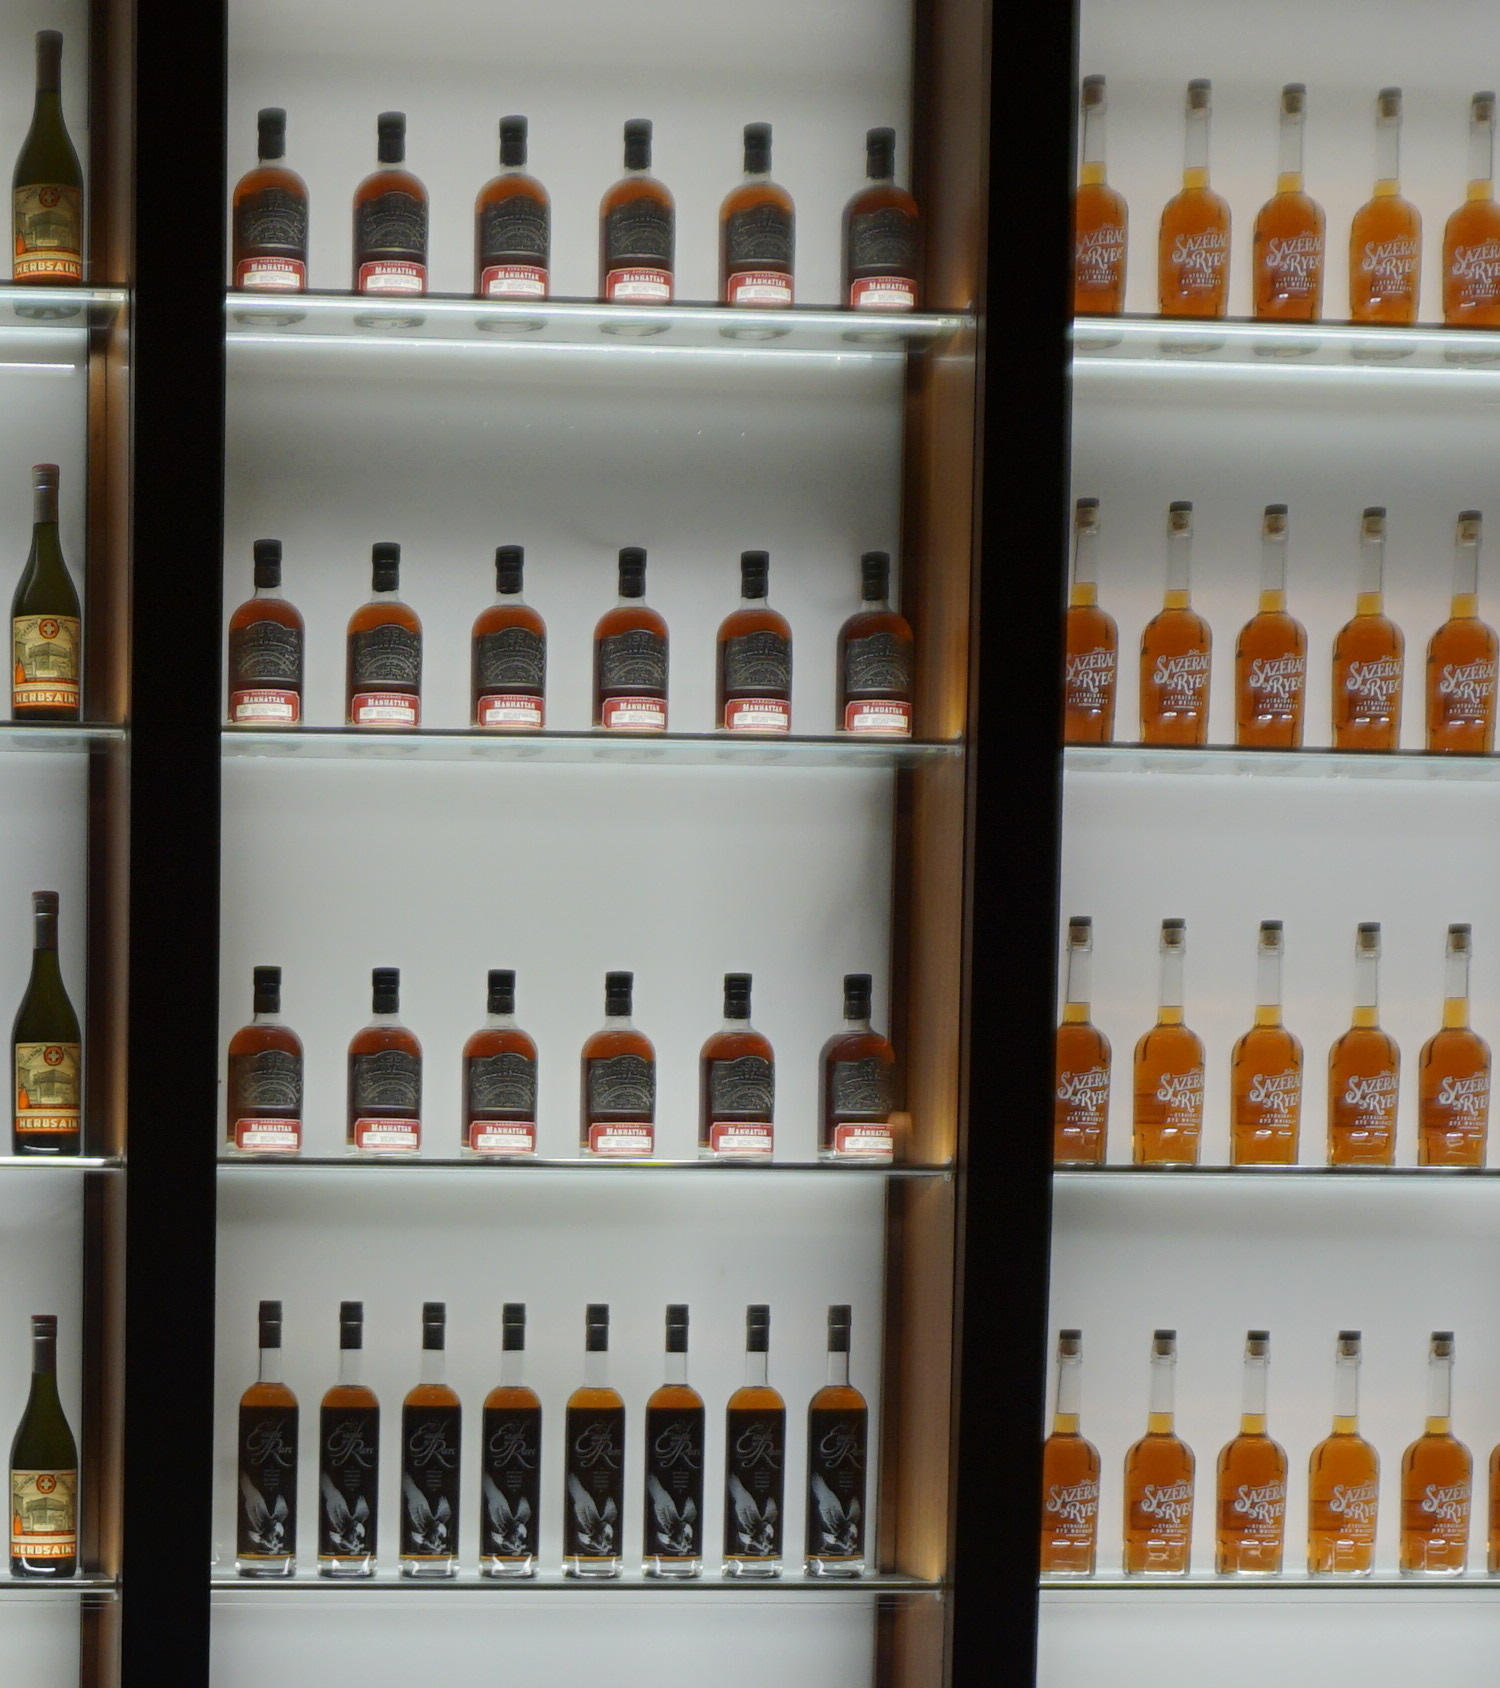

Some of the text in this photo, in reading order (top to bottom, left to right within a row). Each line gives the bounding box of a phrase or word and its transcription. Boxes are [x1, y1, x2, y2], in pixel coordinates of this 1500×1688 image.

[17, 261, 80, 276] HERBSAINT
[252, 262, 293, 272] MANHATTAN
[1090, 247, 1117, 273] RYE
[1192, 248, 1221, 273] RYE
[1287, 253, 1314, 276] RYE
[1379, 257, 1409, 280] RYE
[376, 266, 416, 276] MANHATTAN
[498, 271, 539, 280] MANHATTAN
[623, 274, 664, 283] MANHATTAN
[1470, 262, 1500, 283] RYE
[746, 277, 785, 287] MANHATTAN
[869, 282, 909, 291] MANHATTAN
[1082, 670, 1108, 692] RYE
[1177, 673, 1202, 695] RYE
[1272, 676, 1299, 698] RYE
[1368, 680, 1395, 700] RYE
[16, 692, 79, 704] HERBSAINT
[244, 694, 284, 703] MANHATTAN
[368, 697, 409, 706] MANHATTAN
[1461, 682, 1488, 703] RYE
[495, 700, 535, 709] MANHATTAN
[620, 702, 660, 711] MANHATTAN
[743, 703, 782, 712] MANHATTAN
[863, 705, 903, 714] MANHATTAN
[1157, 1072, 1203, 1101] SAZER
[1249, 1073, 1300, 1102] SAZERA
[1346, 1075, 1398, 1104] SAZERA
[1438, 1075, 1488, 1105] SAZERA
[1078, 1090, 1105, 1111] RYE
[1178, 1092, 1202, 1112] RYE
[1270, 1092, 1297, 1111] RYE
[1366, 1093, 1393, 1114] RYE
[1459, 1094, 1484, 1114] RYE
[19, 1118, 78, 1129] HERBSAIN
[251, 1124, 292, 1132] MANHATTAN
[372, 1124, 412, 1133] MANHATTAN
[486, 1127, 526, 1135] MANHATTAN
[606, 1128, 646, 1136] MANHATTAN
[728, 1127, 767, 1135] MANHATTAN
[1143, 1484, 1193, 1512] SAZERA
[1067, 1502, 1093, 1524] RYE
[1163, 1503, 1189, 1524] RYE
[1256, 1504, 1281, 1524] RYE
[14, 1545, 75, 1555] HERBSAINT
